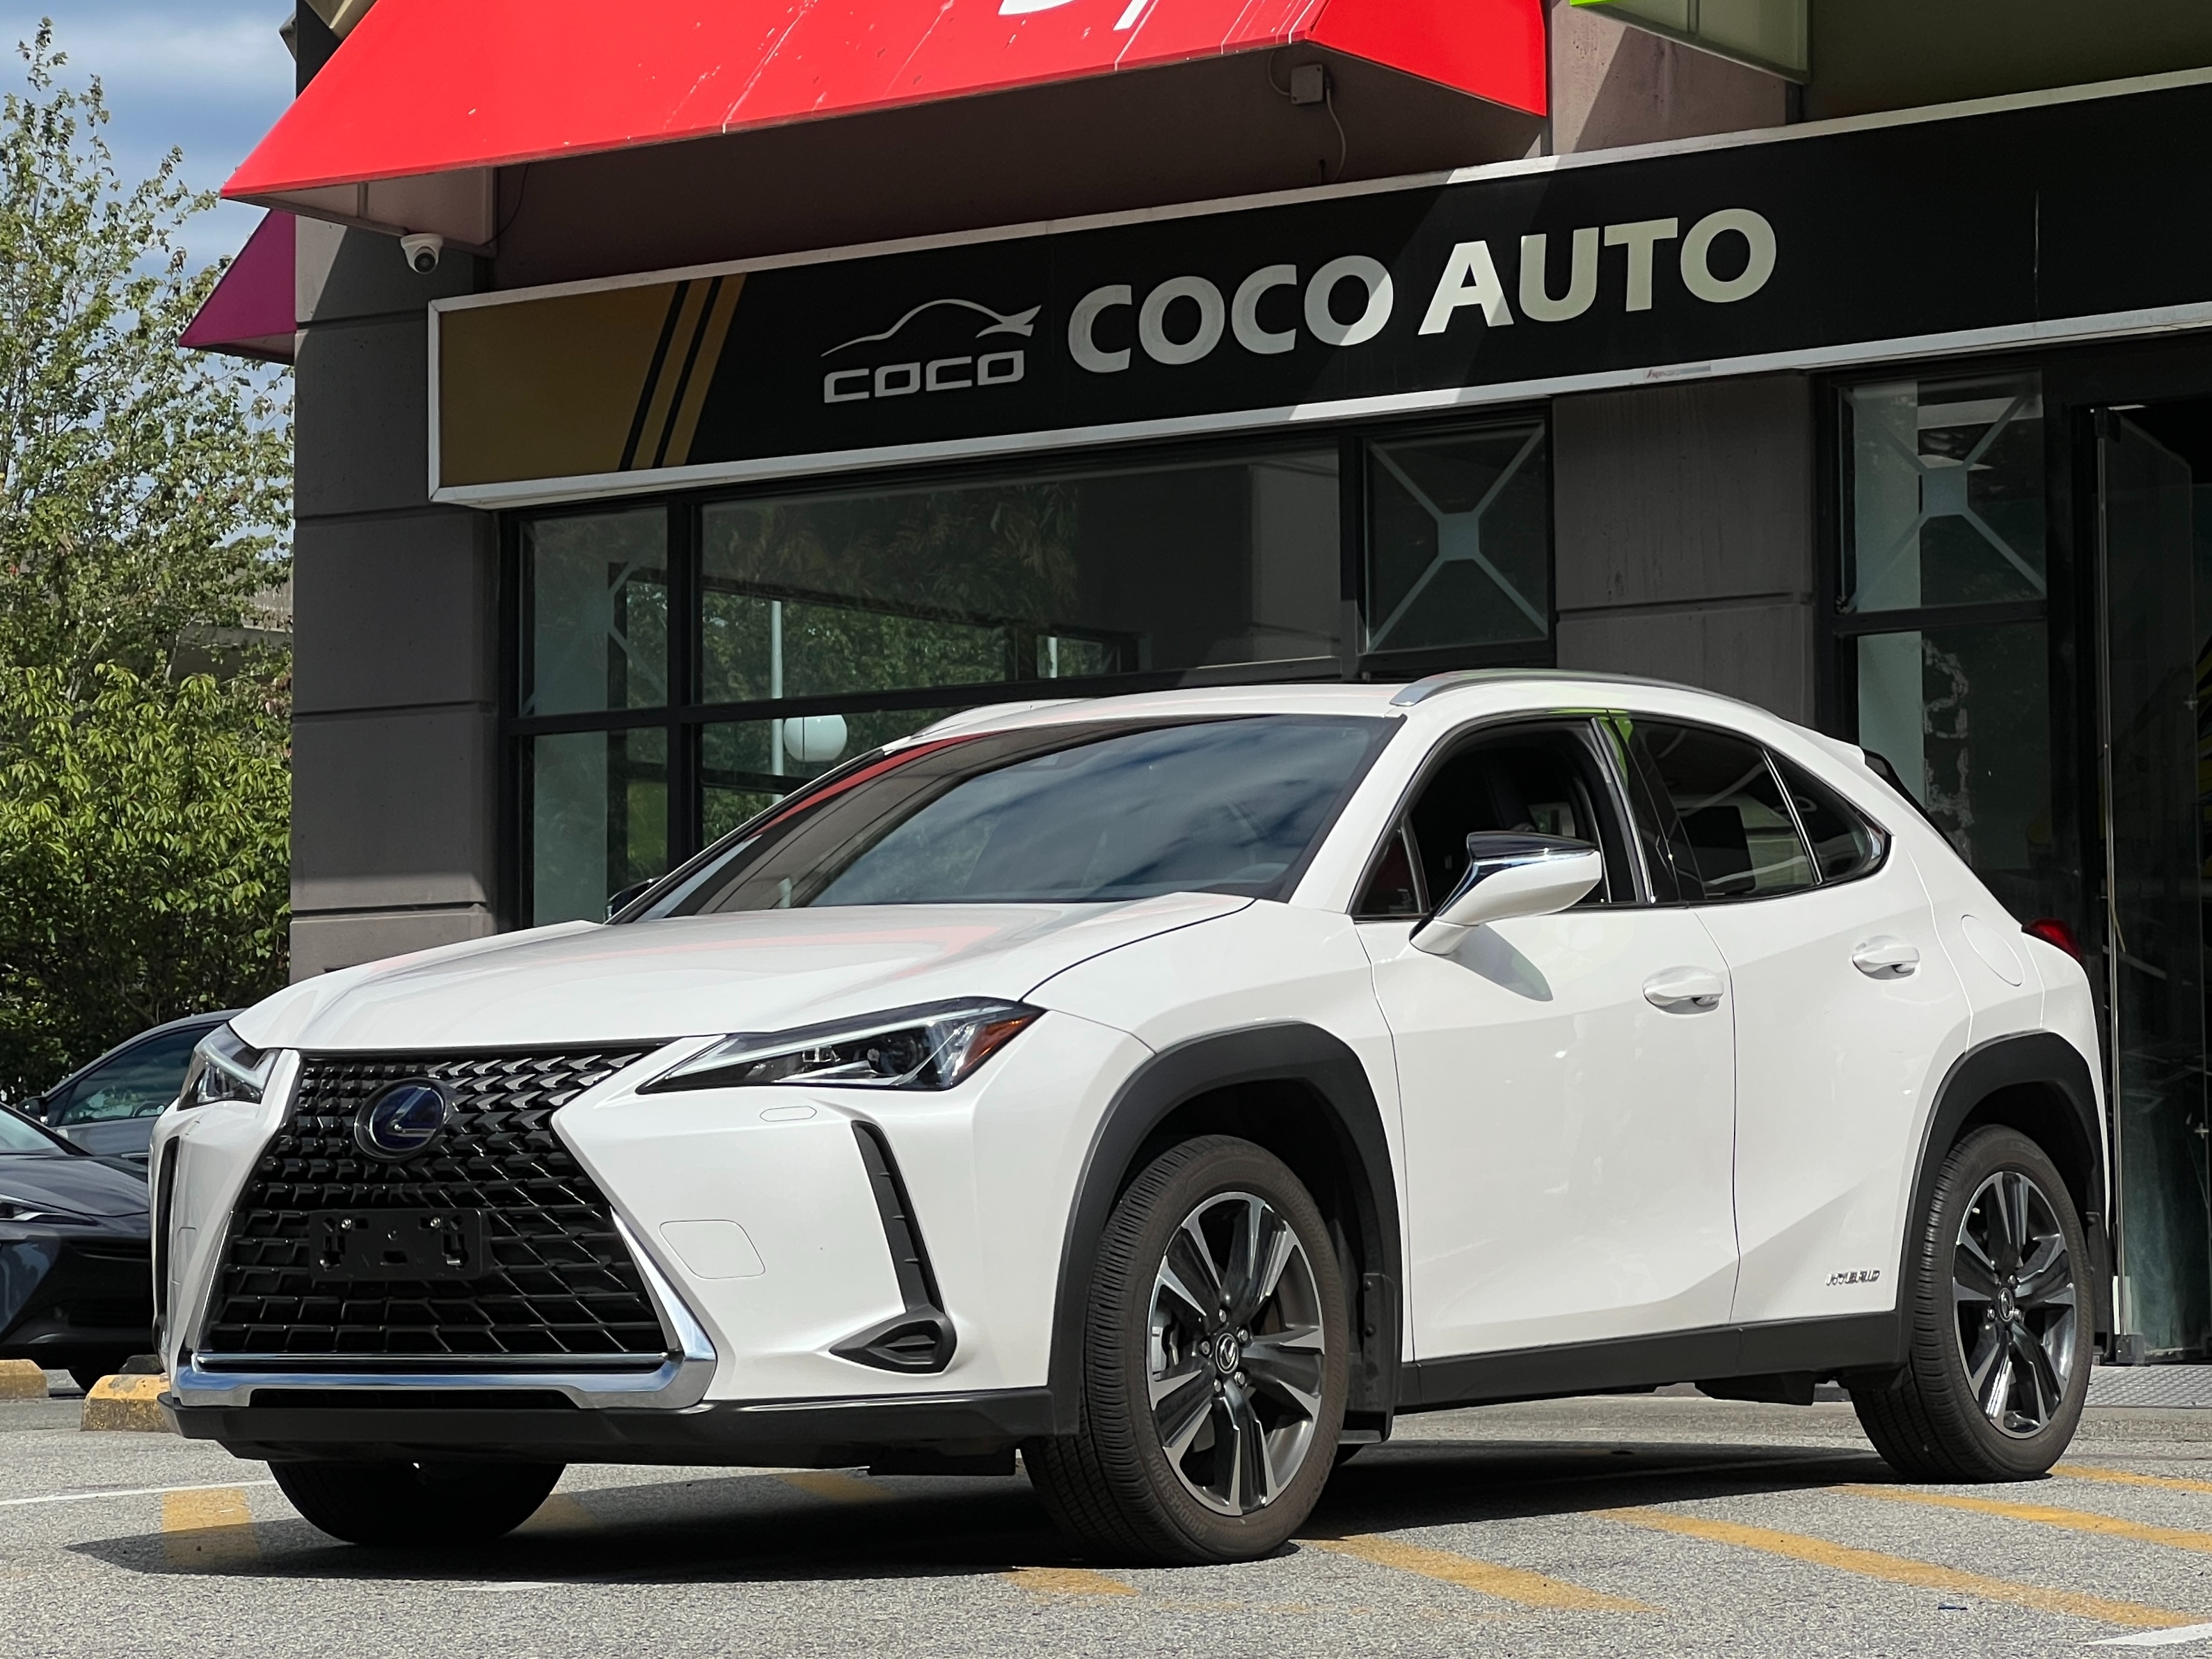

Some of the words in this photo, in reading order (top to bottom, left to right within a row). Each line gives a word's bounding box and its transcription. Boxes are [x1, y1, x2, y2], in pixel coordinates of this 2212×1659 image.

[1068, 255, 1394, 373] COCO
[1418, 208, 1777, 335] AUTO
[824, 350, 1024, 403] COCO
[1825, 1270, 1880, 1286] HYBRID
